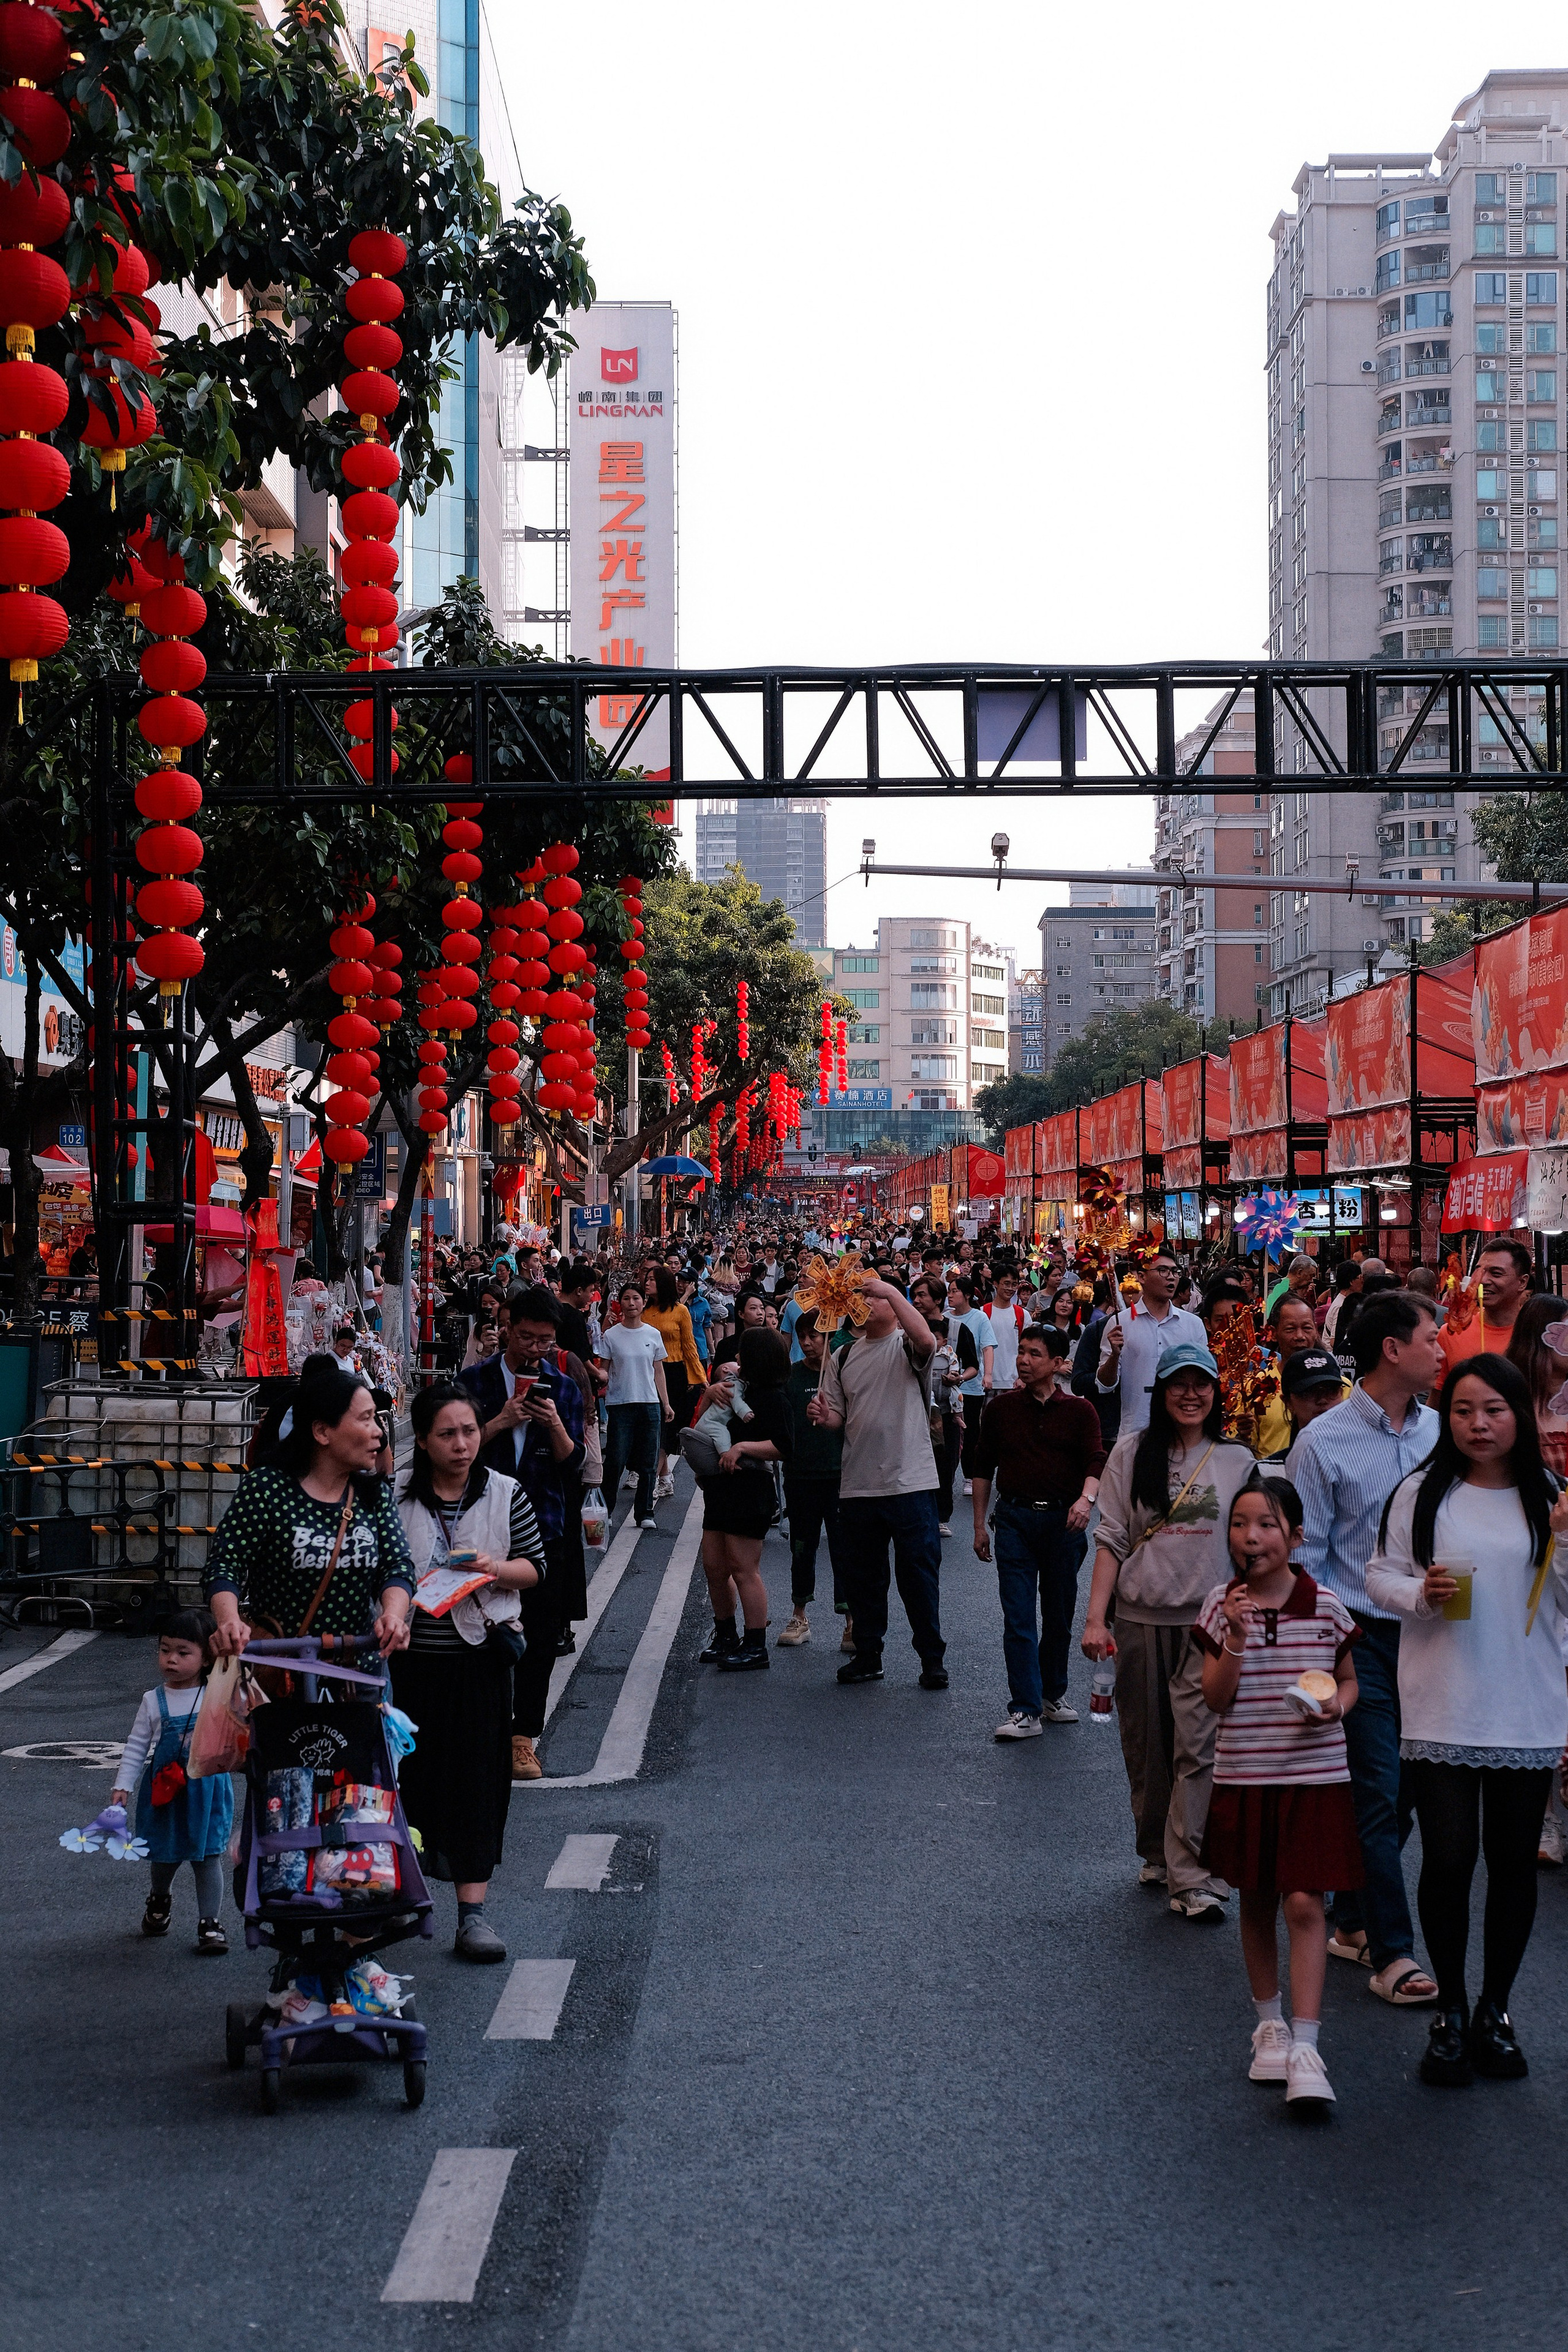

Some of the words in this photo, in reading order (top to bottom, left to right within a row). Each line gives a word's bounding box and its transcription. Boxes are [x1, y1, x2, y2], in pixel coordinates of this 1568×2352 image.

[578, 404, 663, 418] LINGNAN
[834, 1090, 888, 1101] 赛楠酒店
[63, 1134, 81, 1144] 102
[1487, 1164, 1513, 1193] 手工制作
[1448, 1172, 1485, 1219] 澳门手信
[584, 1207, 602, 1219] 出口
[1297, 1199, 1359, 1219] 杏粉
[69, 1310, 89, 1332] 察
[292, 1526, 351, 1550] Best
[288, 1724, 319, 1743] LITTLE
[322, 1724, 348, 1749] TIGER
